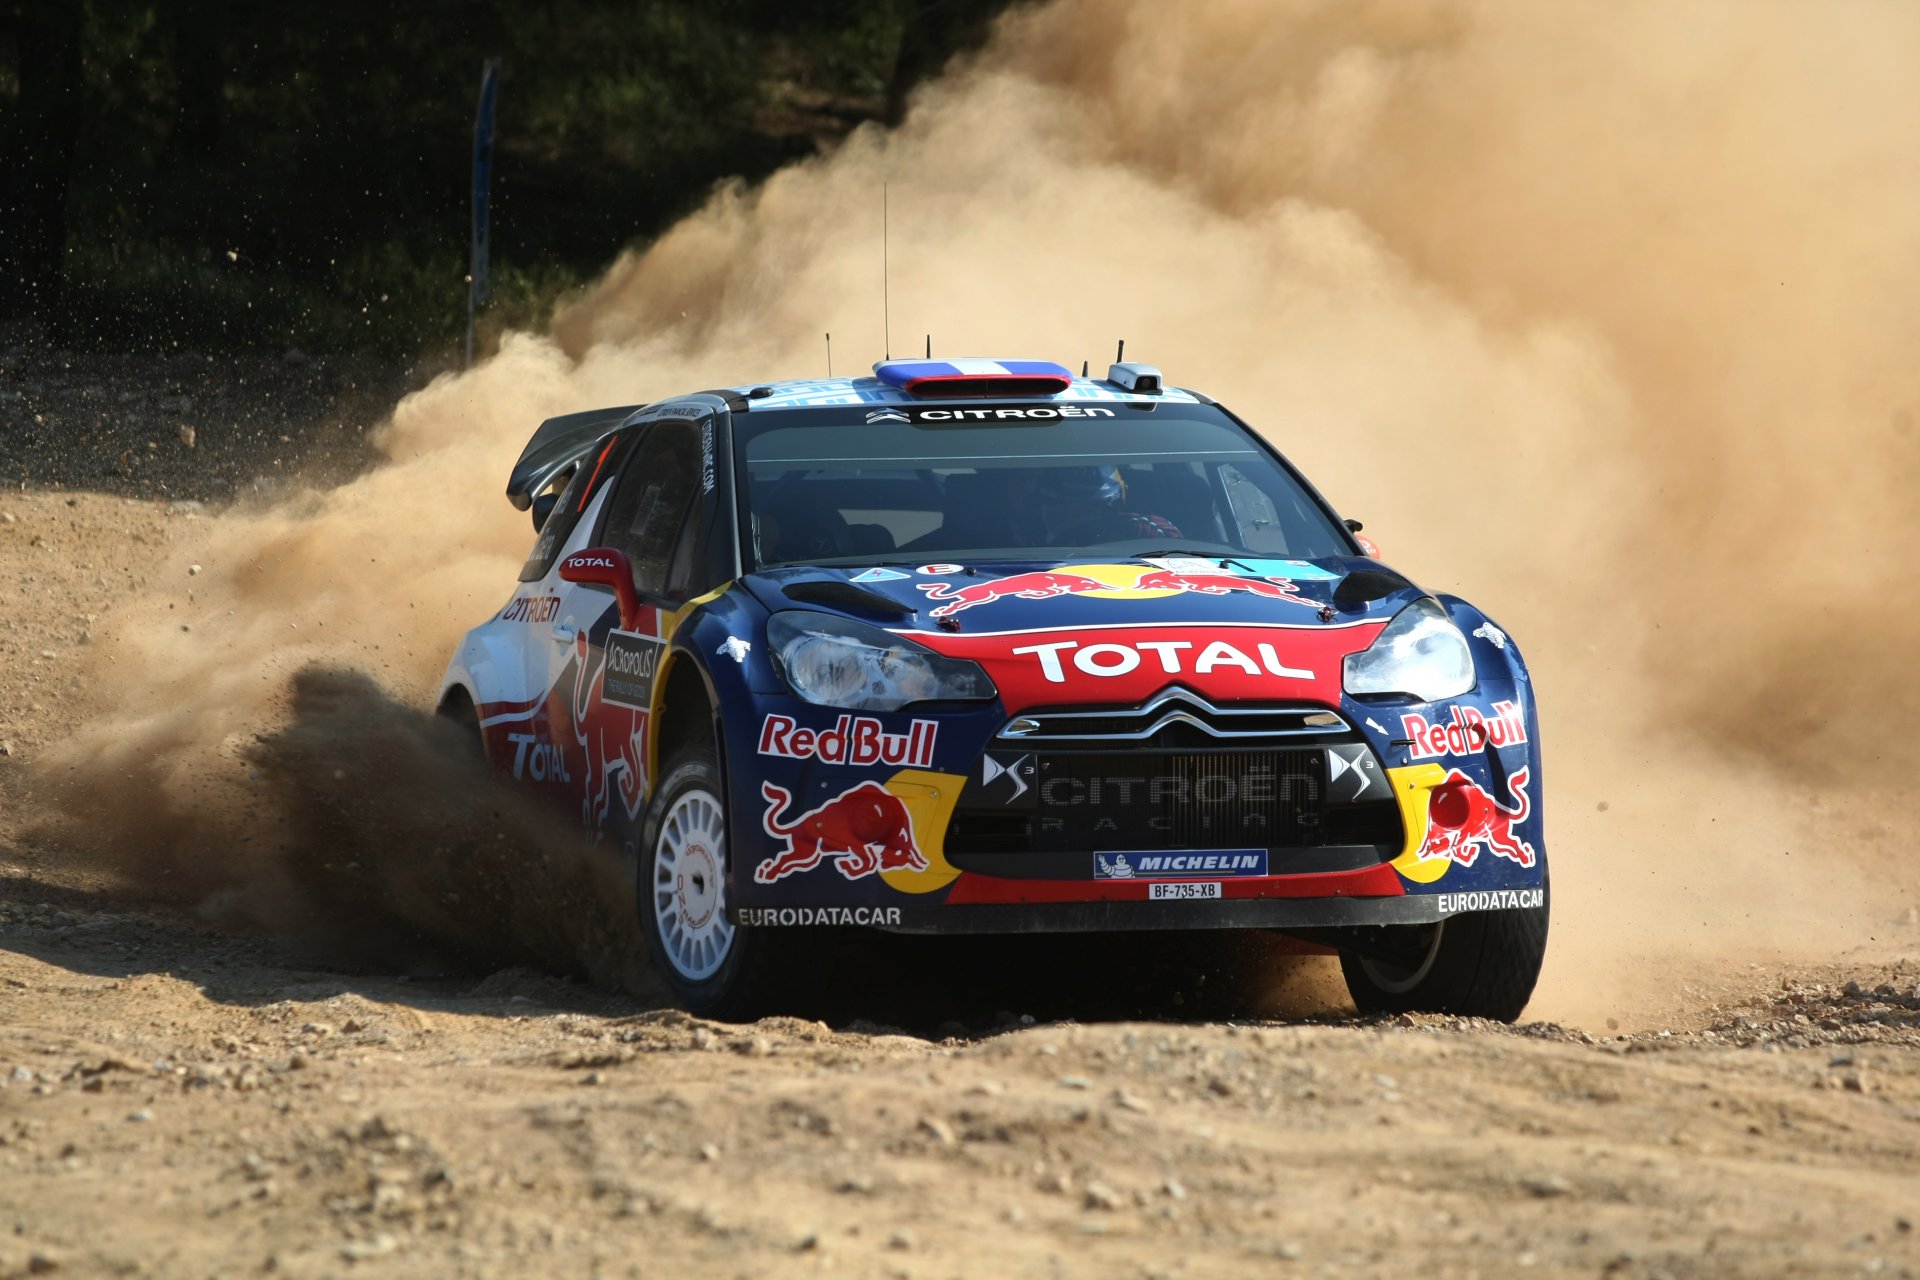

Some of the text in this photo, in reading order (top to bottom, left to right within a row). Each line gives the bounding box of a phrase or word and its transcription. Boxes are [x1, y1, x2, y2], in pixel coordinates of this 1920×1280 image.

[920, 405, 1115, 421] CITROËN
[567, 556, 615, 568] TOTAL
[926, 564, 954, 575] E
[502, 587, 561, 623] CITROËN
[607, 641, 653, 679] ACROPOLIS
[1012, 640, 1316, 683] TOTAL
[759, 714, 938, 767] Red Bull
[1403, 701, 1528, 759] Red Bull
[507, 732, 571, 783] TOTAL
[1041, 765, 1319, 806] CITROËN
[1041, 812, 1320, 831] RACING
[1138, 855, 1260, 871] MICHELIN
[1154, 884, 1216, 899] BF-735-XB
[1438, 890, 1544, 913] EURODATACAR
[738, 907, 901, 927] EURODATACAR
